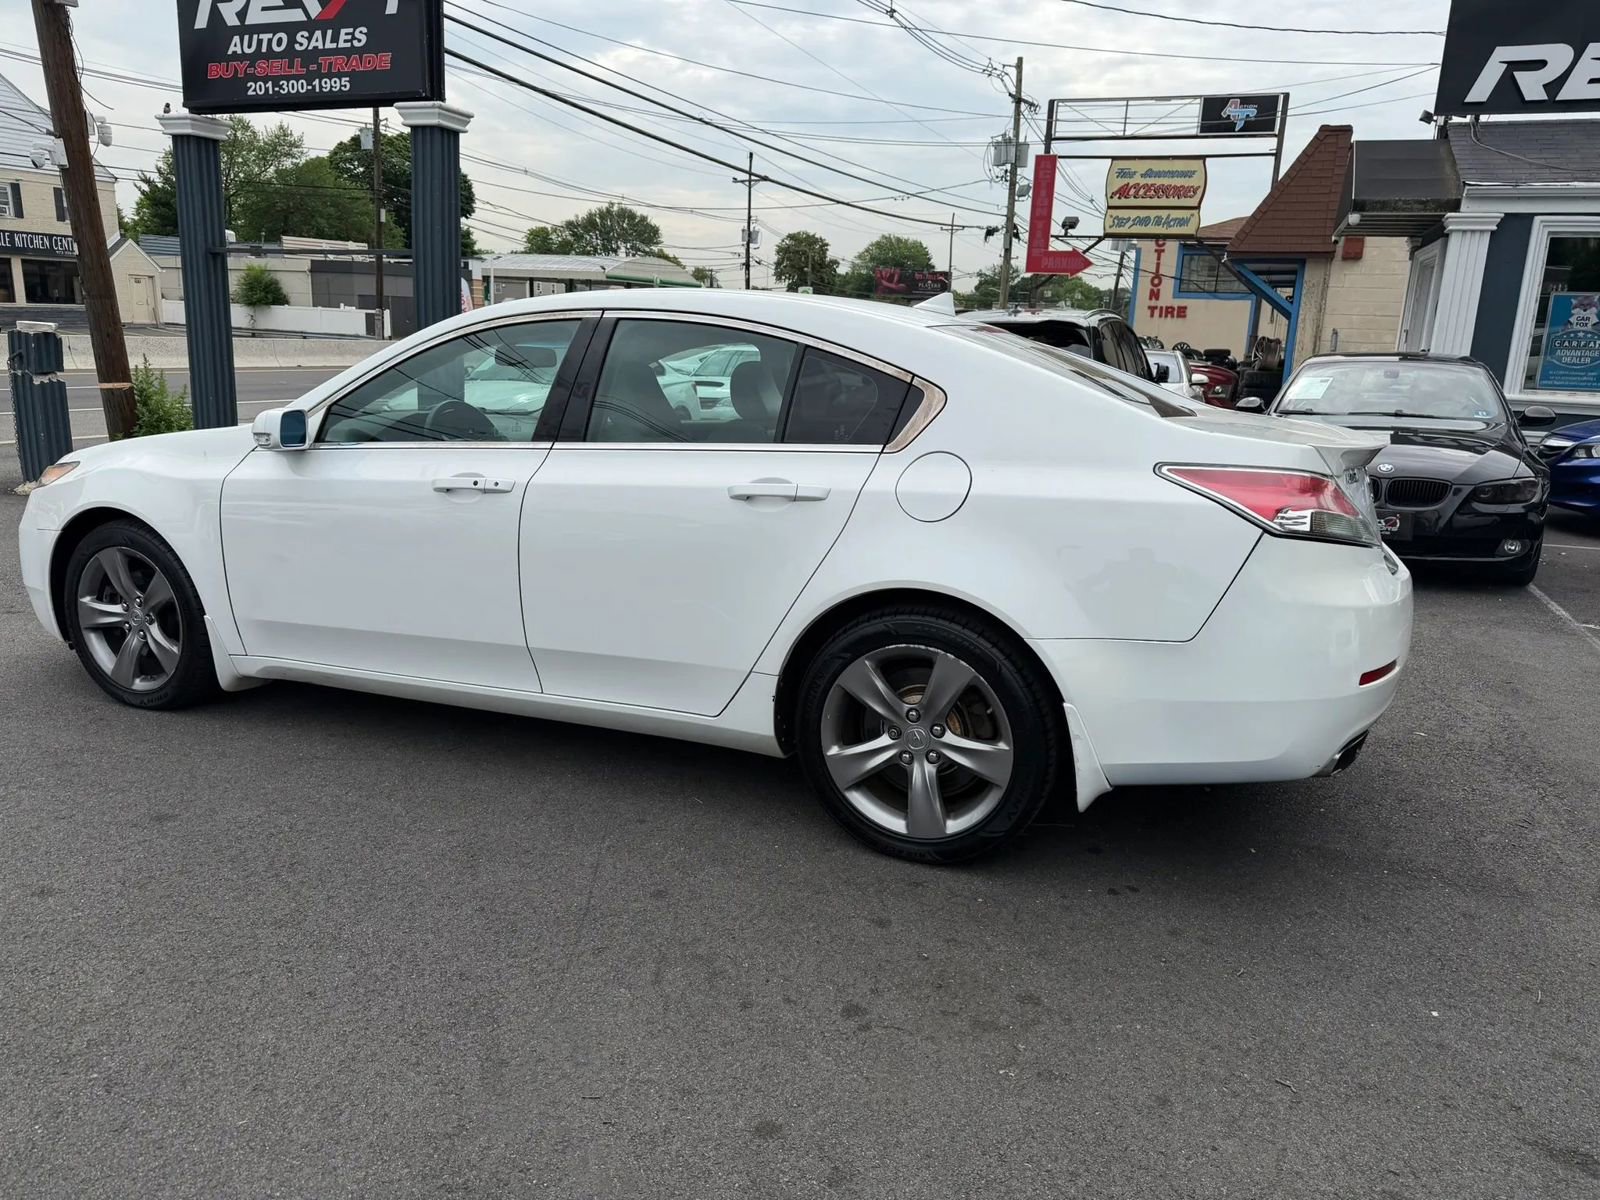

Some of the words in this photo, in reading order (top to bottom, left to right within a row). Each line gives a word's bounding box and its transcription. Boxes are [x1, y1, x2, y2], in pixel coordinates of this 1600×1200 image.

[227, 32, 288, 55] AUTO
[294, 27, 368, 50] SALES
[246, 77, 350, 96] 201-300-1995
[14, 232, 50, 250] KITCHEN
[52, 236, 76, 251] CENT
[1041, 257, 1085, 269] PARKING
[1147, 305, 1188, 319] TIRE
[1556, 349, 1600, 357] ADVANTAGE
[1562, 356, 1591, 364] DEALER
